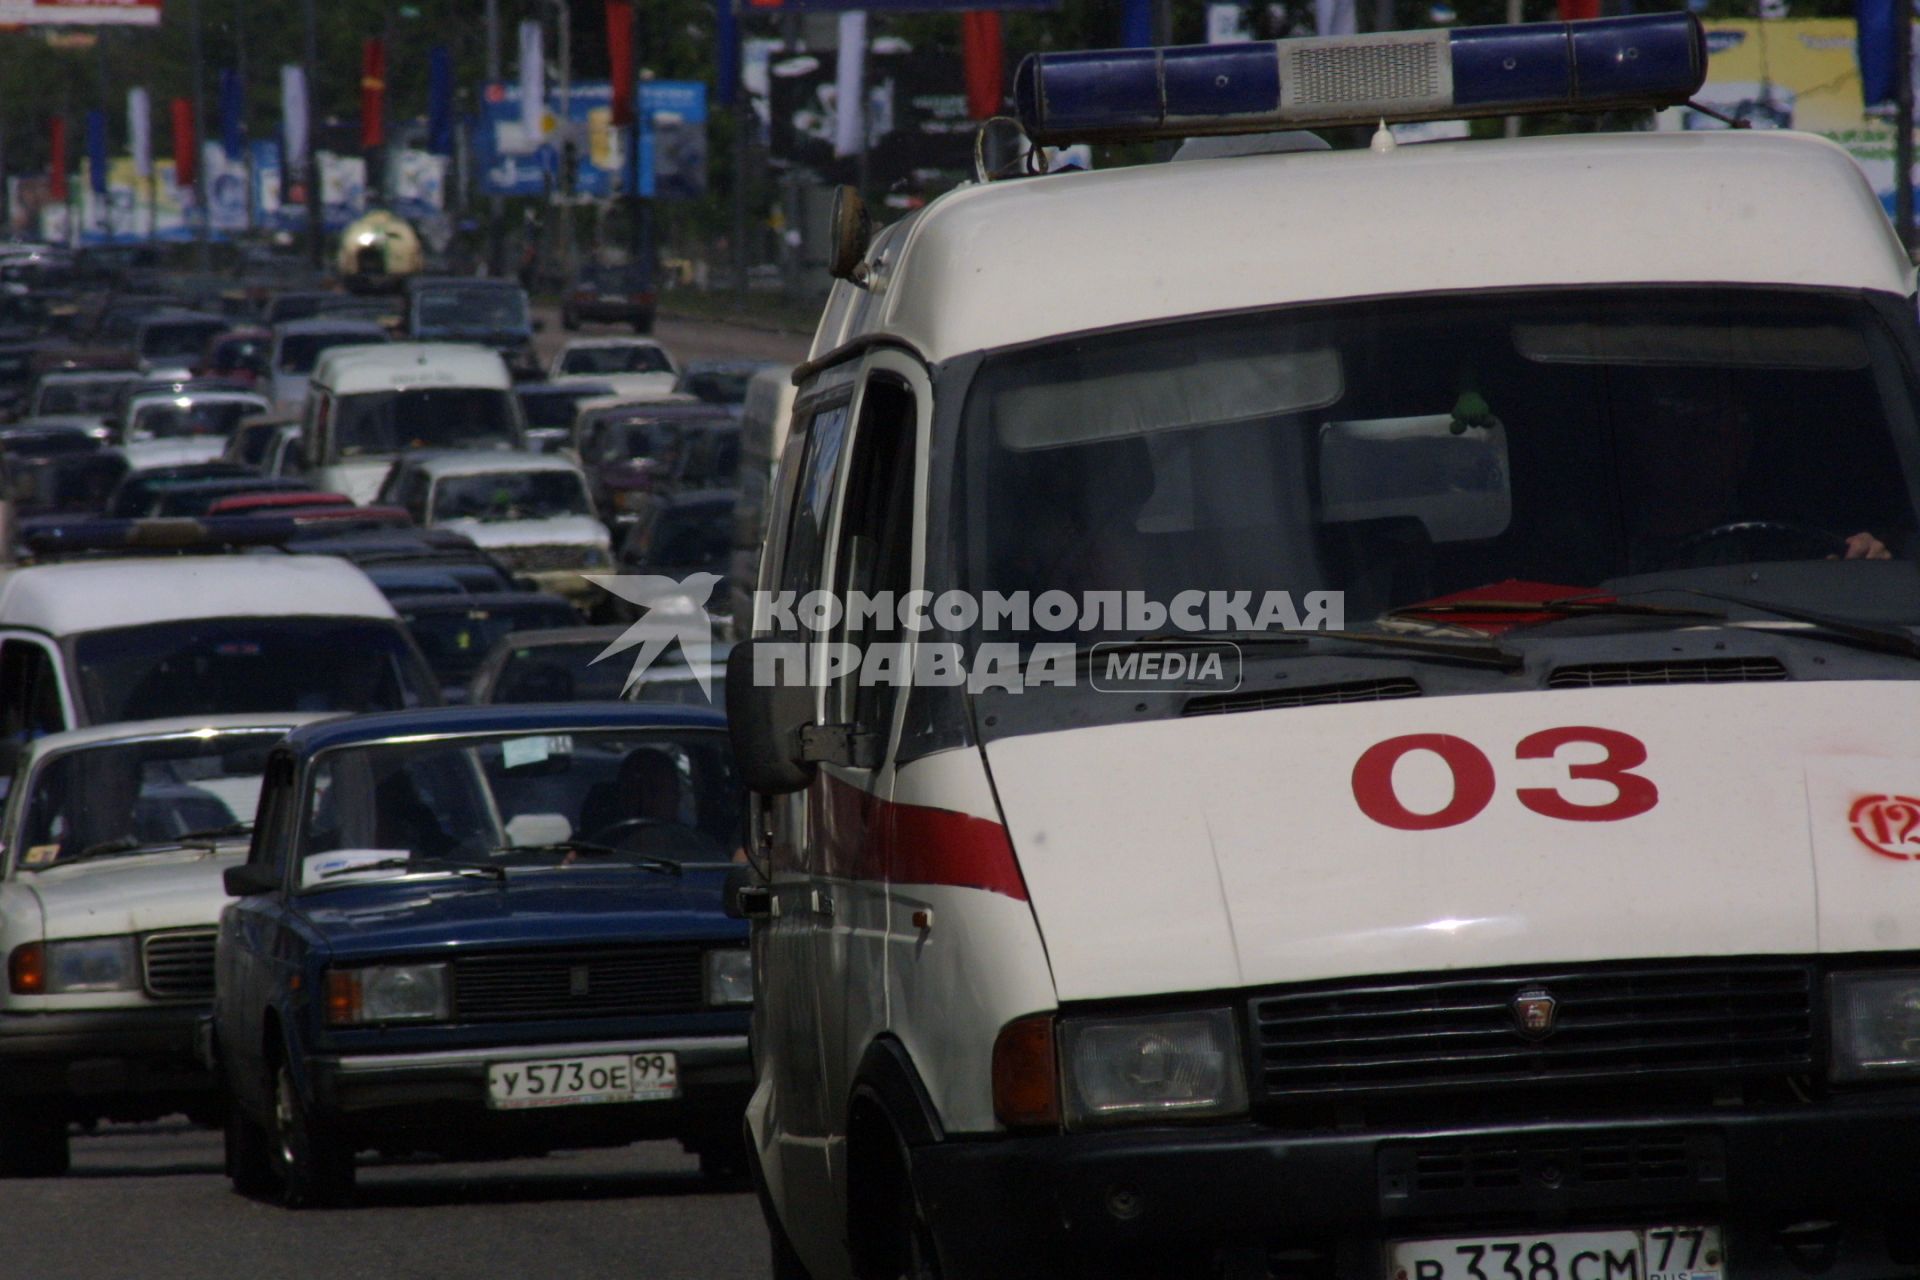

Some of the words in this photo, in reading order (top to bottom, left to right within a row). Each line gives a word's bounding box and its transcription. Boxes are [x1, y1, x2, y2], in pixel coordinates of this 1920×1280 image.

[1351, 726, 1659, 831] 03
[634, 1055, 666, 1080] 99
[1650, 1230, 1705, 1272] 77
